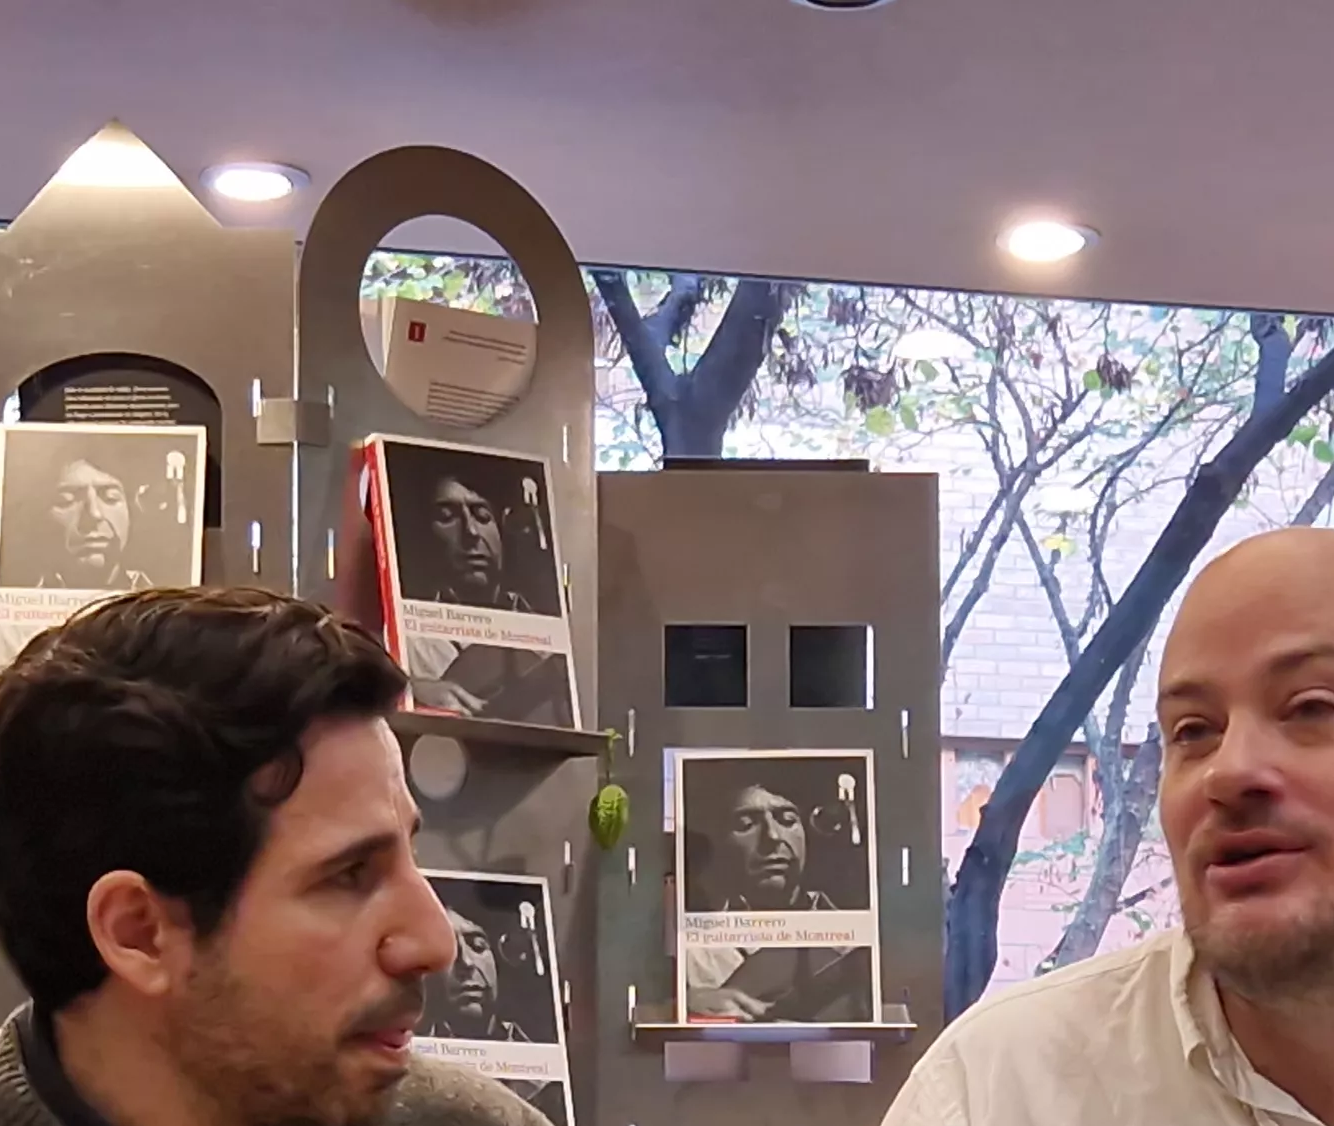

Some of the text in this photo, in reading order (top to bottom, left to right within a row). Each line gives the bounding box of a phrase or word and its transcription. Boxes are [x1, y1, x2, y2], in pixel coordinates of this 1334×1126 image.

[403, 604, 492, 625] Miguel Barrero
[405, 619, 417, 630] El
[420, 622, 482, 638] guitarrista
[484, 629, 499, 638] de
[685, 917, 786, 930] Miguel Barrero
[685, 930, 855, 944] El guitarrista de Montreal
[441, 1043, 487, 1057] Barrero
